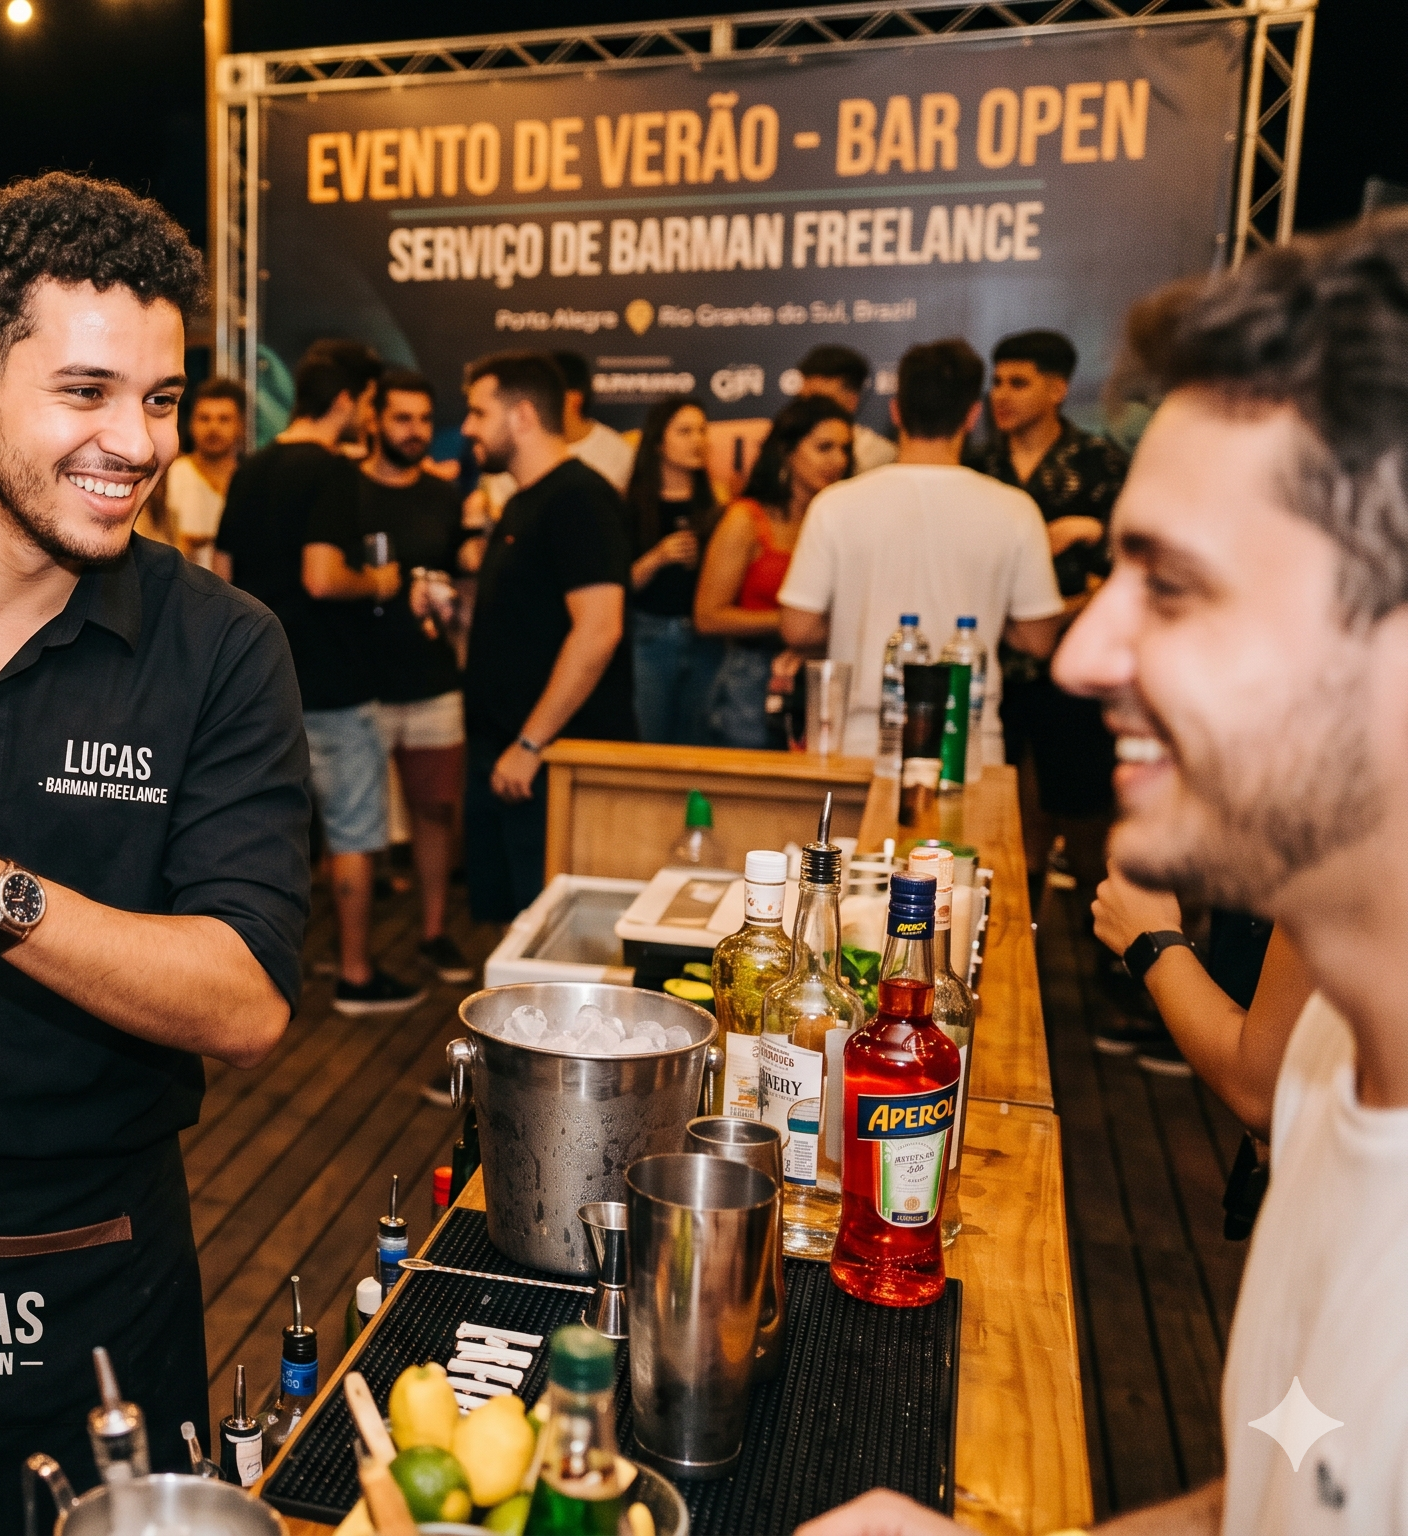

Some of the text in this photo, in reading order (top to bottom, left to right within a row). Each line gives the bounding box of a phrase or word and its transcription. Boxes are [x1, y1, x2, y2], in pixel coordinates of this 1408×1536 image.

[308, 121, 501, 204] EVENTO
[513, 116, 584, 194] DE
[595, 90, 780, 189] VERÃO
[835, 92, 961, 177] BAR
[976, 78, 1150, 169] OPEN
[388, 201, 1044, 289] SERVIÇO DE BARMAN FREELANCE
[551, 306, 619, 334] Alegre
[657, 304, 694, 328] Rio
[695, 301, 775, 327] Grande
[776, 300, 808, 325] do
[64, 739, 153, 781] LUCAS
[46, 777, 169, 804] BARMAN FREELANCE
[868, 1095, 955, 1132] APEROL
